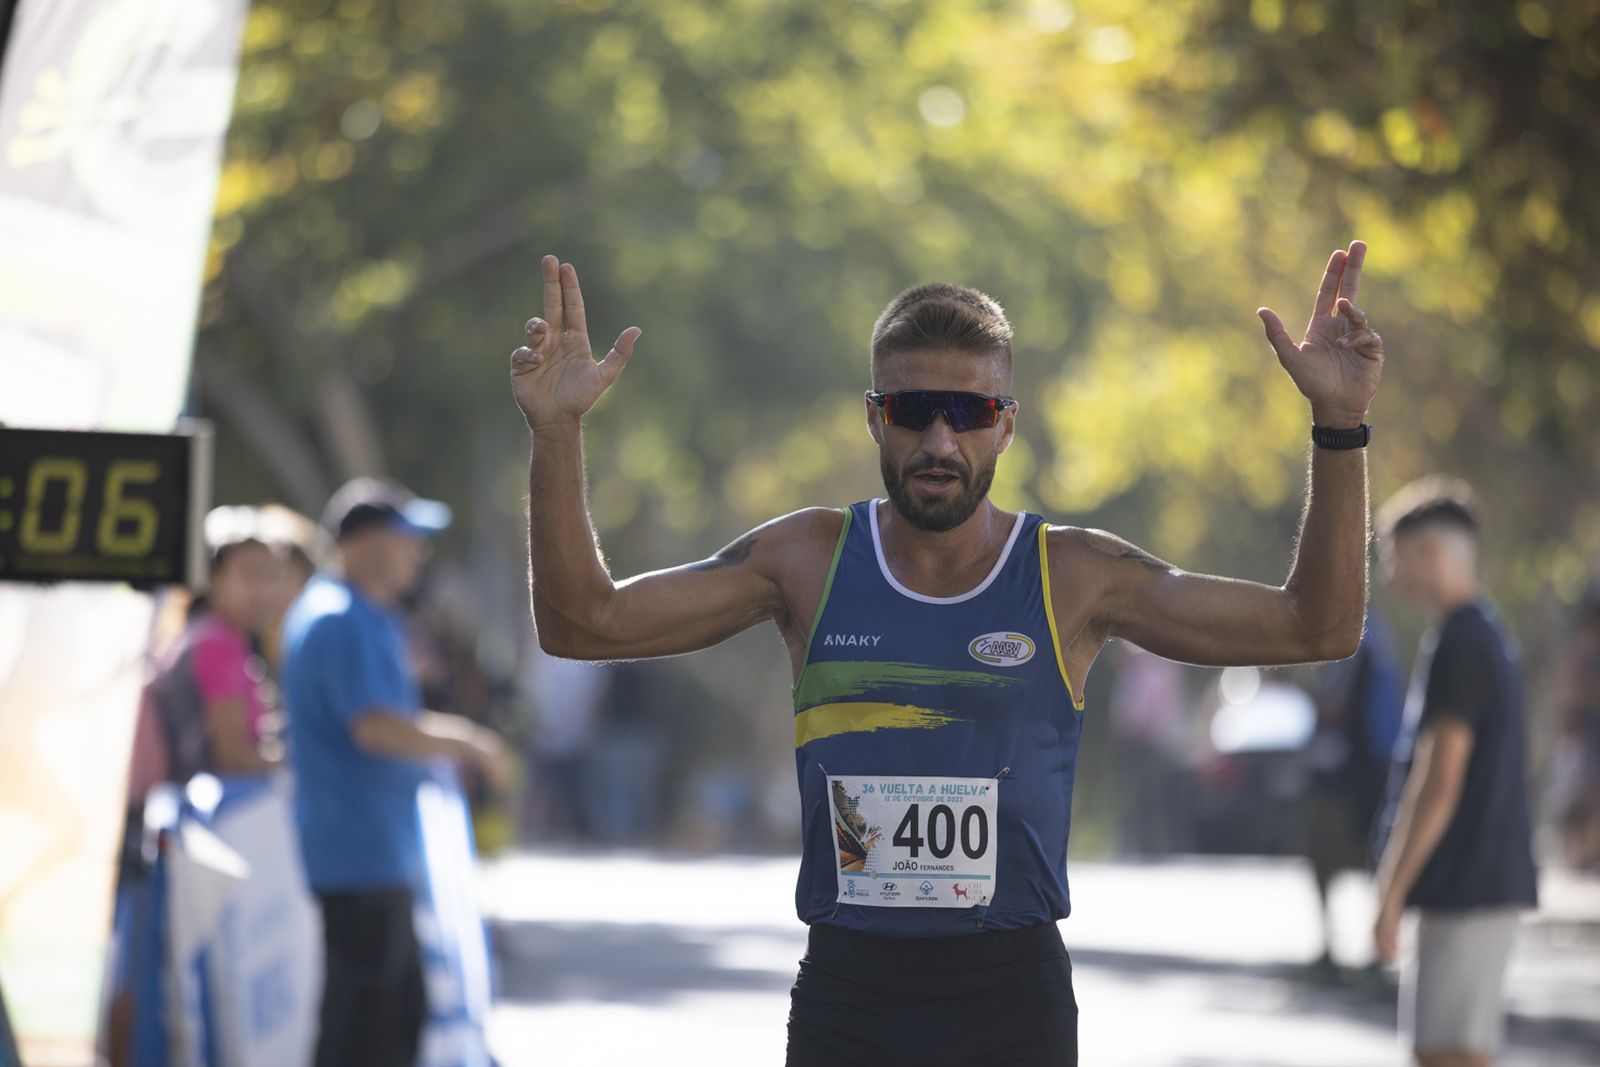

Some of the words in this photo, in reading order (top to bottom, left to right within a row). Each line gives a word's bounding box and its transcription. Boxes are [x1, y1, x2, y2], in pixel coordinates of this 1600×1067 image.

[824, 634, 882, 647] ANAKY
[862, 783, 875, 794] 36
[880, 783, 924, 795] VUELTA
[928, 784, 937, 795] A
[941, 784, 987, 797] HUELVA
[892, 803, 989, 860] 400
[892, 859, 918, 871] JOÃO
